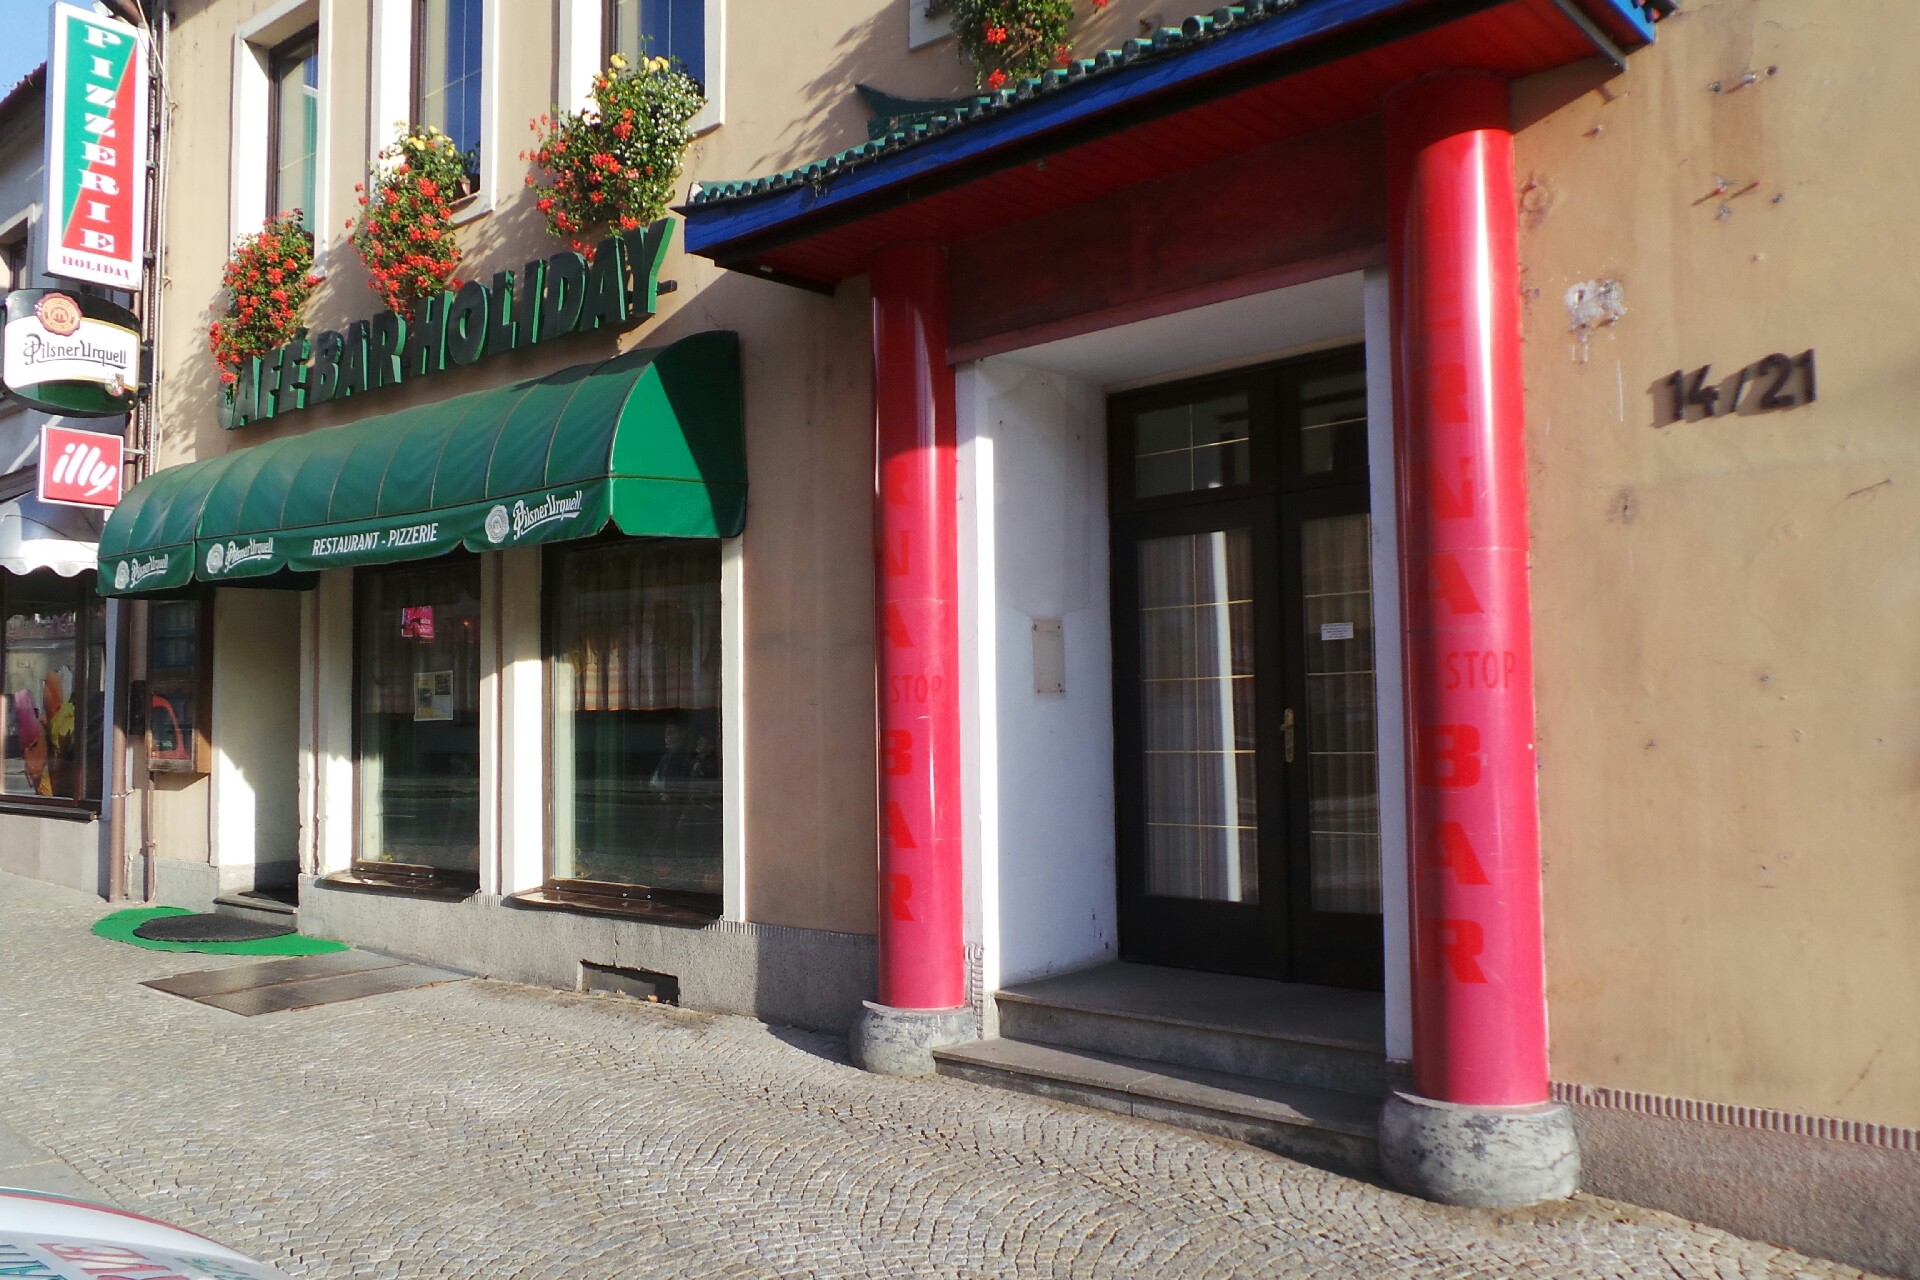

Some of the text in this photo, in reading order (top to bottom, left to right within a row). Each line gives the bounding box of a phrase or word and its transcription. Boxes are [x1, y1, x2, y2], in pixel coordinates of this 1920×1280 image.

[78, 25, 122, 254] PIZZERIE
[62, 255, 130, 280] HOLIDAY
[310, 310, 407, 404] BAR
[411, 217, 676, 377] HOLIDAY
[23, 333, 127, 367] Pilsner Urquell
[1660, 348, 1816, 424] 14/21
[52, 443, 117, 496] illy
[312, 532, 380, 556] RESTAURANT
[387, 522, 439, 547] PIZZERIE
[512, 499, 549, 541] Pilsner
[546, 489, 583, 521] Urquell
[880, 728, 918, 922] BAR
[1417, 723, 1491, 984] BAR
